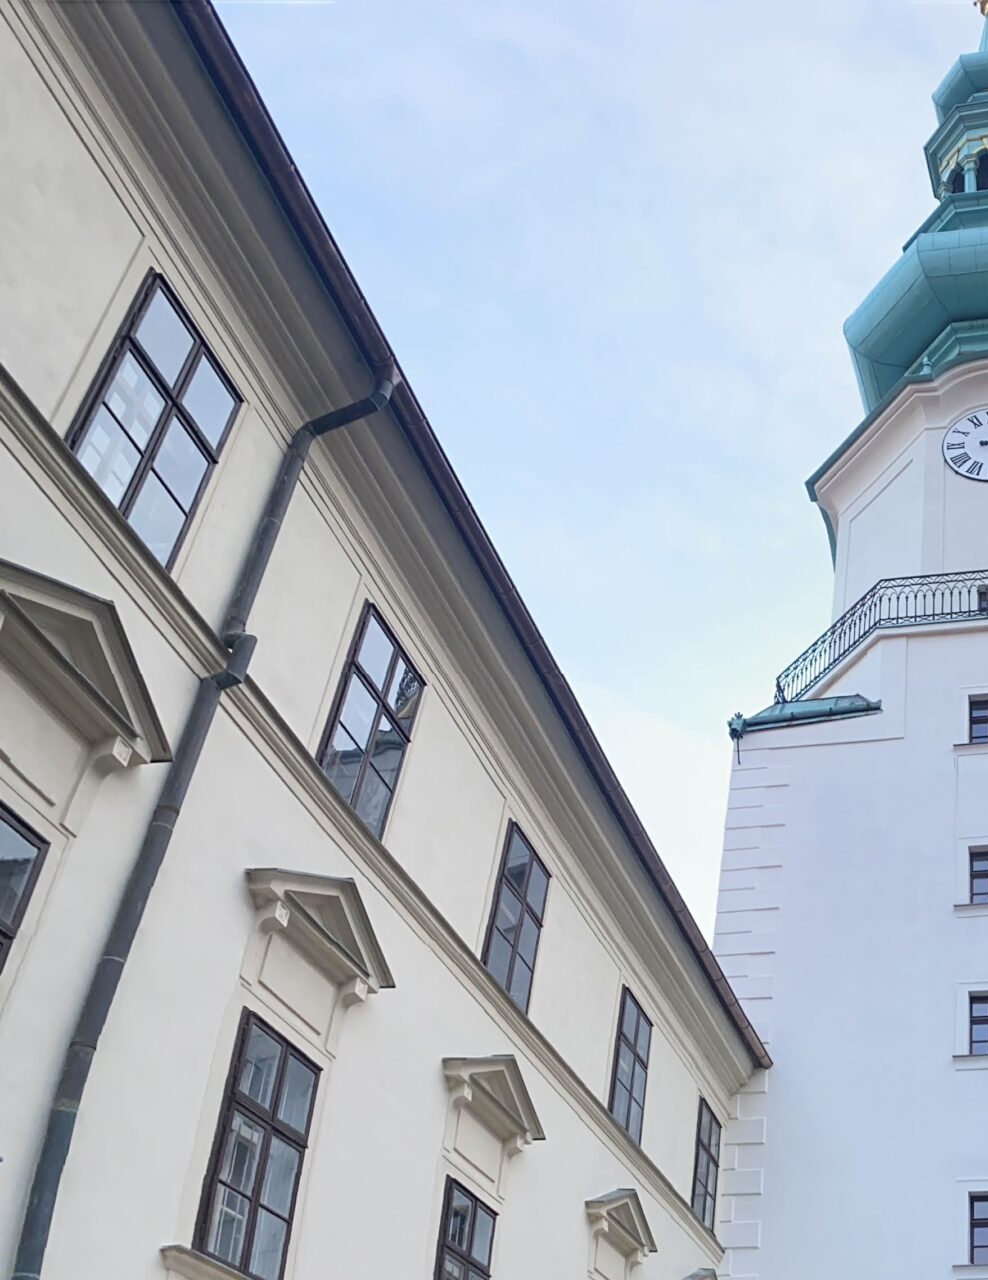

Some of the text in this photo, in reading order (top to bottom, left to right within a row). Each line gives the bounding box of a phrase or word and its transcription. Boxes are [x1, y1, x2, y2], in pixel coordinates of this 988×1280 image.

[967, 415, 983, 429] XI
[952, 428, 970, 437] X
[947, 442, 965, 450] IX
[965, 461, 984, 476] VII
